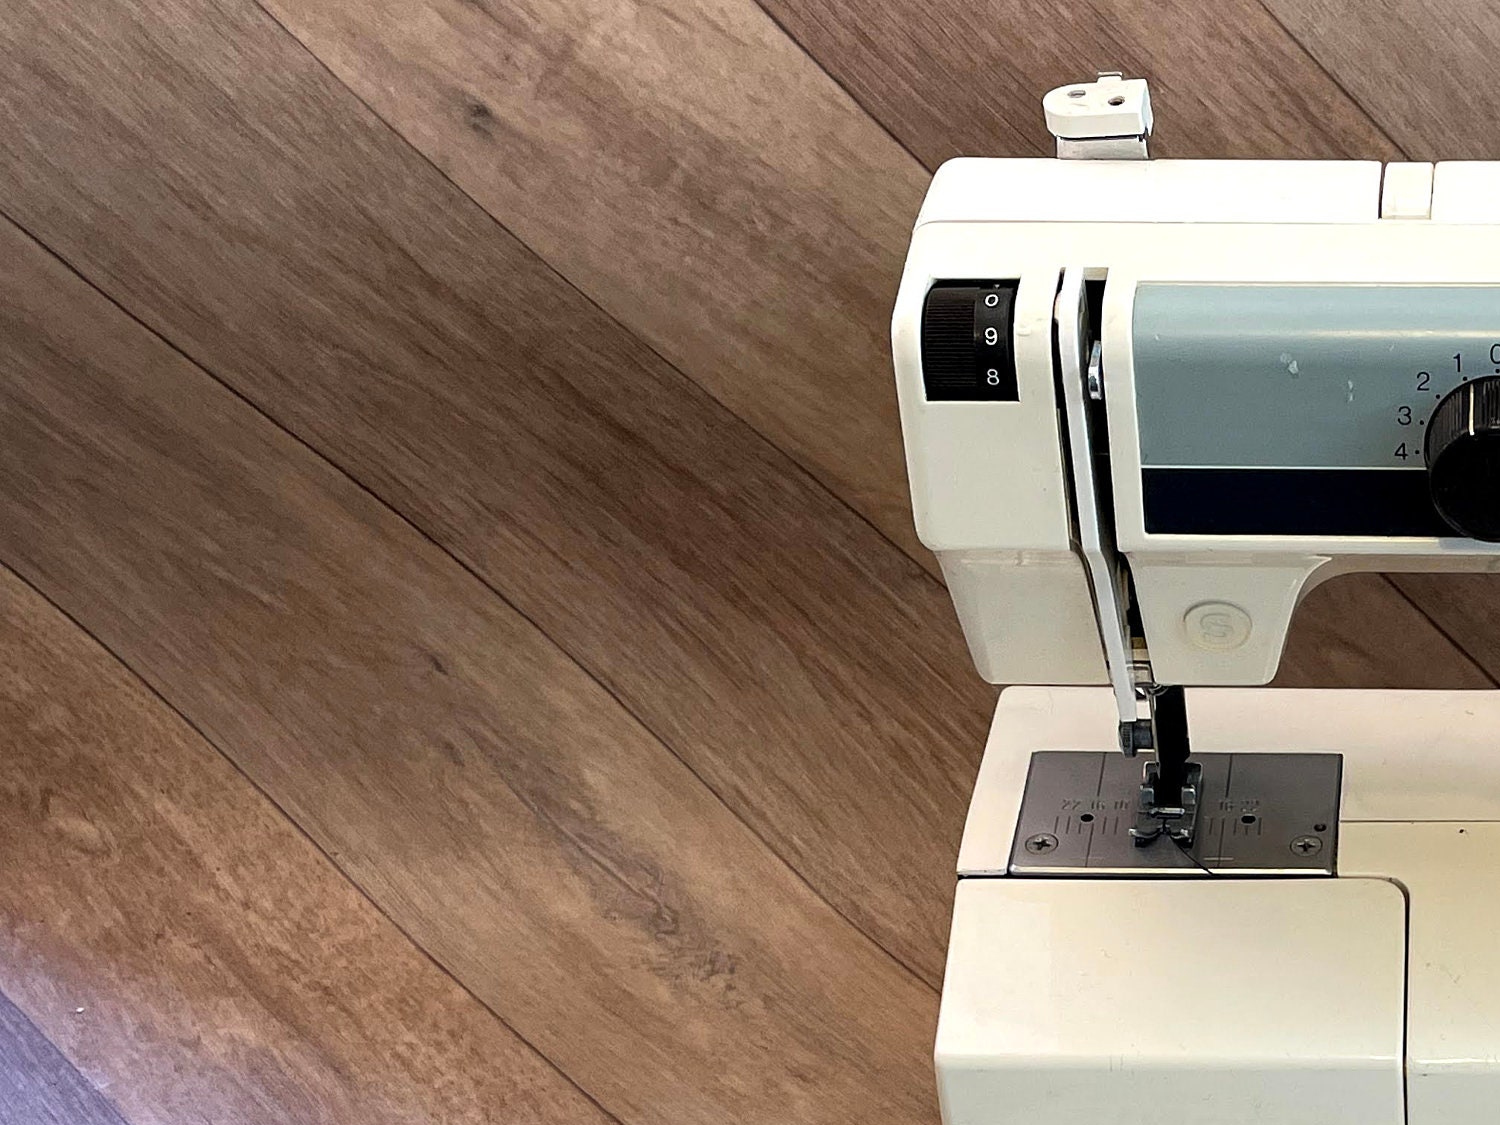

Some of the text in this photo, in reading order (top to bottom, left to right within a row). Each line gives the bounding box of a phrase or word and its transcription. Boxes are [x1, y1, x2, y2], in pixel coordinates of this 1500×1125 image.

[984, 326, 998, 346] 9
[1453, 354, 1461, 373] 1
[986, 368, 1000, 386] 8
[1416, 372, 1430, 391] 2
[1397, 406, 1412, 425] 3
[1394, 442, 1408, 460] 4
